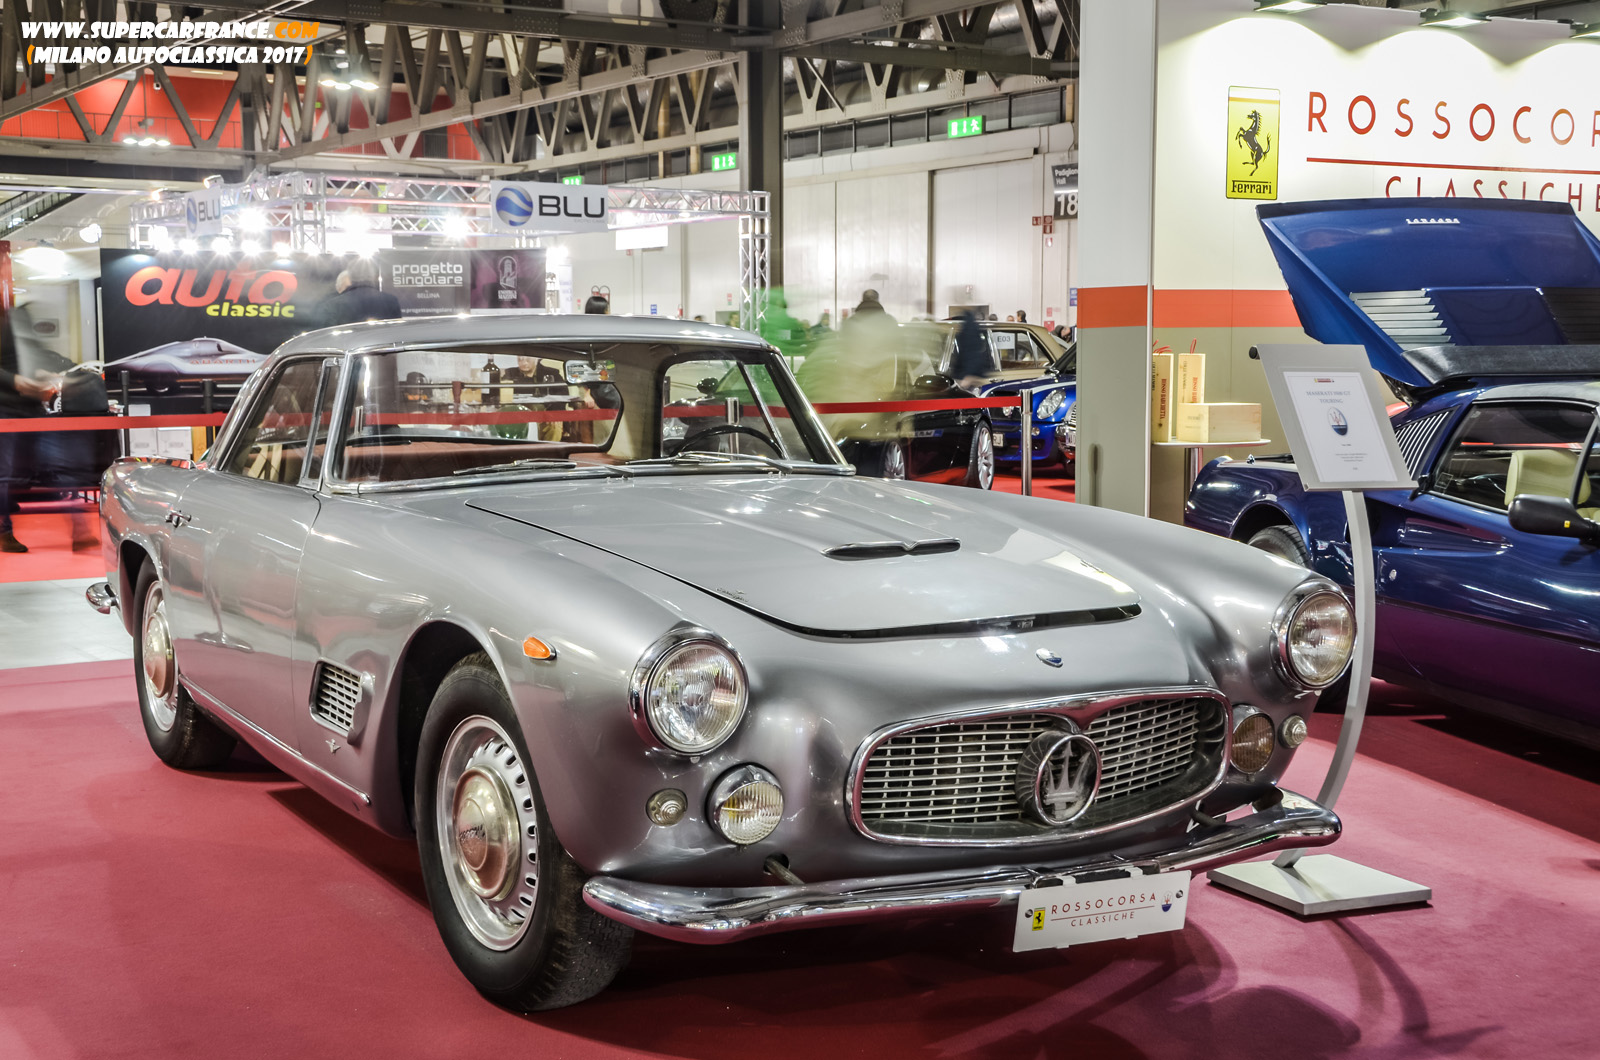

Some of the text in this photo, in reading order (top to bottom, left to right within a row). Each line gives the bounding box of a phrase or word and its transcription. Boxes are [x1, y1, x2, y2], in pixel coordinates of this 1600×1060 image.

[1231, 180, 1272, 194] Ferrari
[198, 199, 221, 222] BLU
[538, 195, 605, 218] BLU
[1057, 192, 1078, 216] 18
[392, 261, 463, 282] progetto
[393, 275, 463, 287] singolare
[206, 302, 295, 318] classic
[997, 335, 1011, 343] E03
[1051, 892, 1156, 915] ROSSOCORSA
[1071, 911, 1135, 927] CLASSICHE
